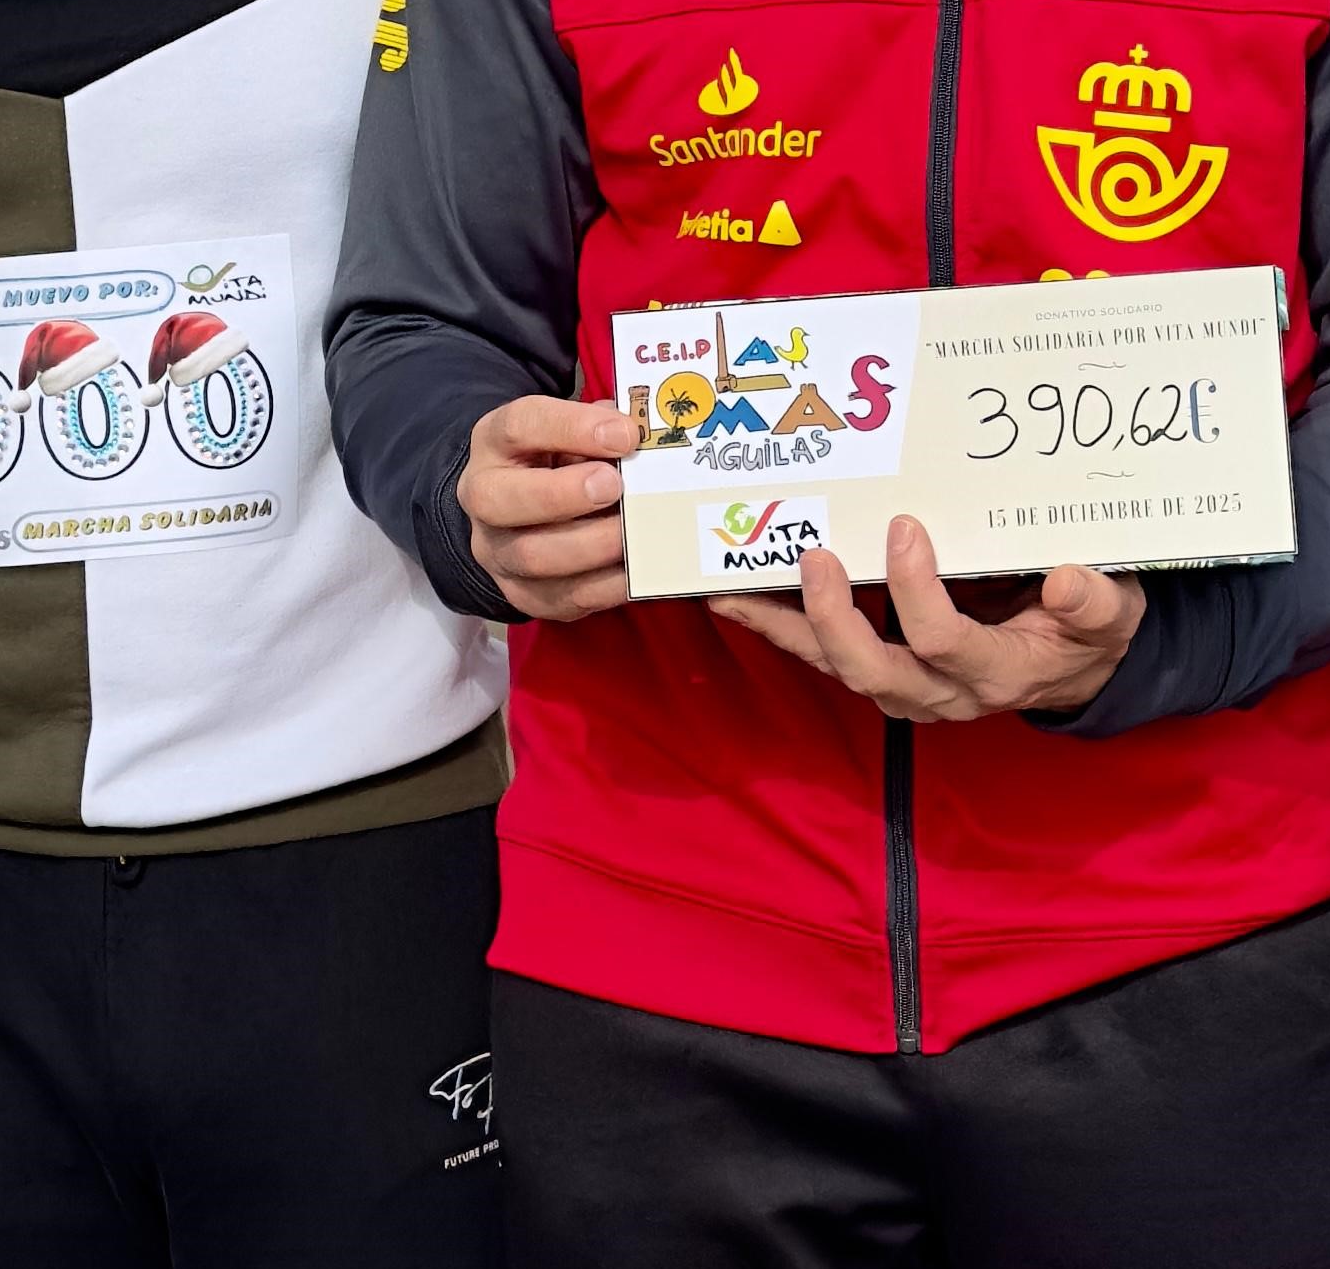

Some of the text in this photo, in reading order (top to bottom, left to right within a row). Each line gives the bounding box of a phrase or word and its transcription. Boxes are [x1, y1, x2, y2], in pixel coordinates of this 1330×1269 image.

[649, 120, 822, 167] Santander
[3, 284, 89, 308] MUEVO
[99, 281, 159, 300] POR:
[1036, 304, 1163, 321] DONATIVO SOLIDARIO
[1113, 326, 1146, 346] POR
[1154, 323, 1194, 341] VITA
[23, 499, 272, 540] MARCHA SOLIDARIA
[988, 492, 1243, 529] 15 DE DICIEMBRE DE 2025
[444, 1147, 480, 1169] FUTURE
